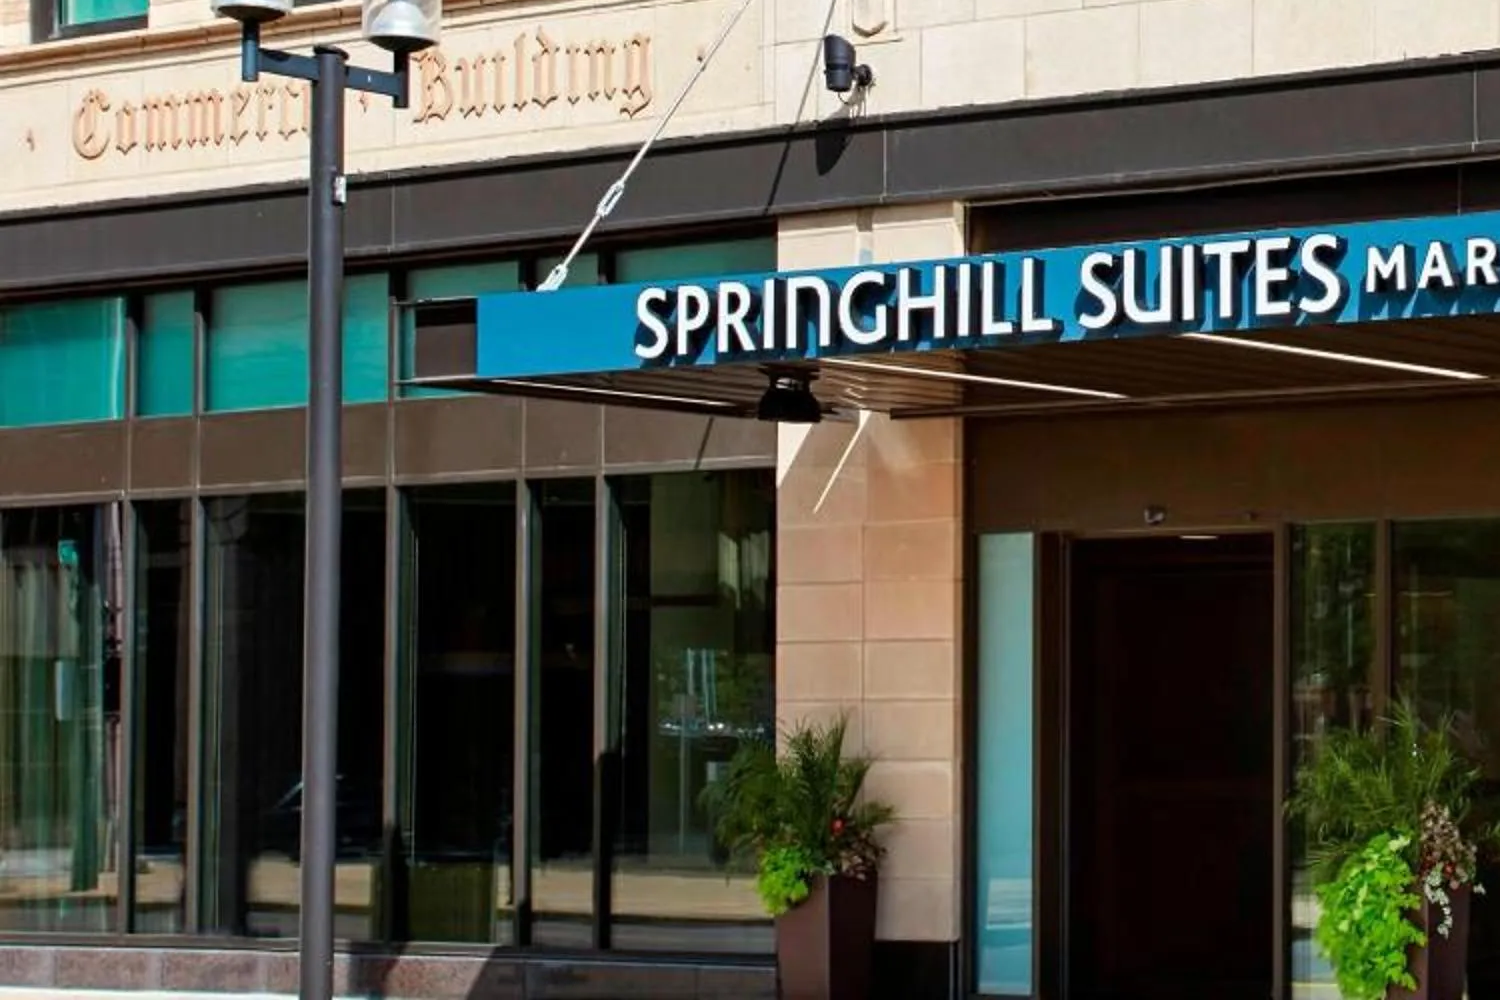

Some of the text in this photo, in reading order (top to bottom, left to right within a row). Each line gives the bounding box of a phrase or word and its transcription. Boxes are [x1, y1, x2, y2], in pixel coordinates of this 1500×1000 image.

[411, 26, 652, 124] Building
[634, 257, 1054, 359] SPRINGHILL
[1079, 233, 1340, 331] SUITES
